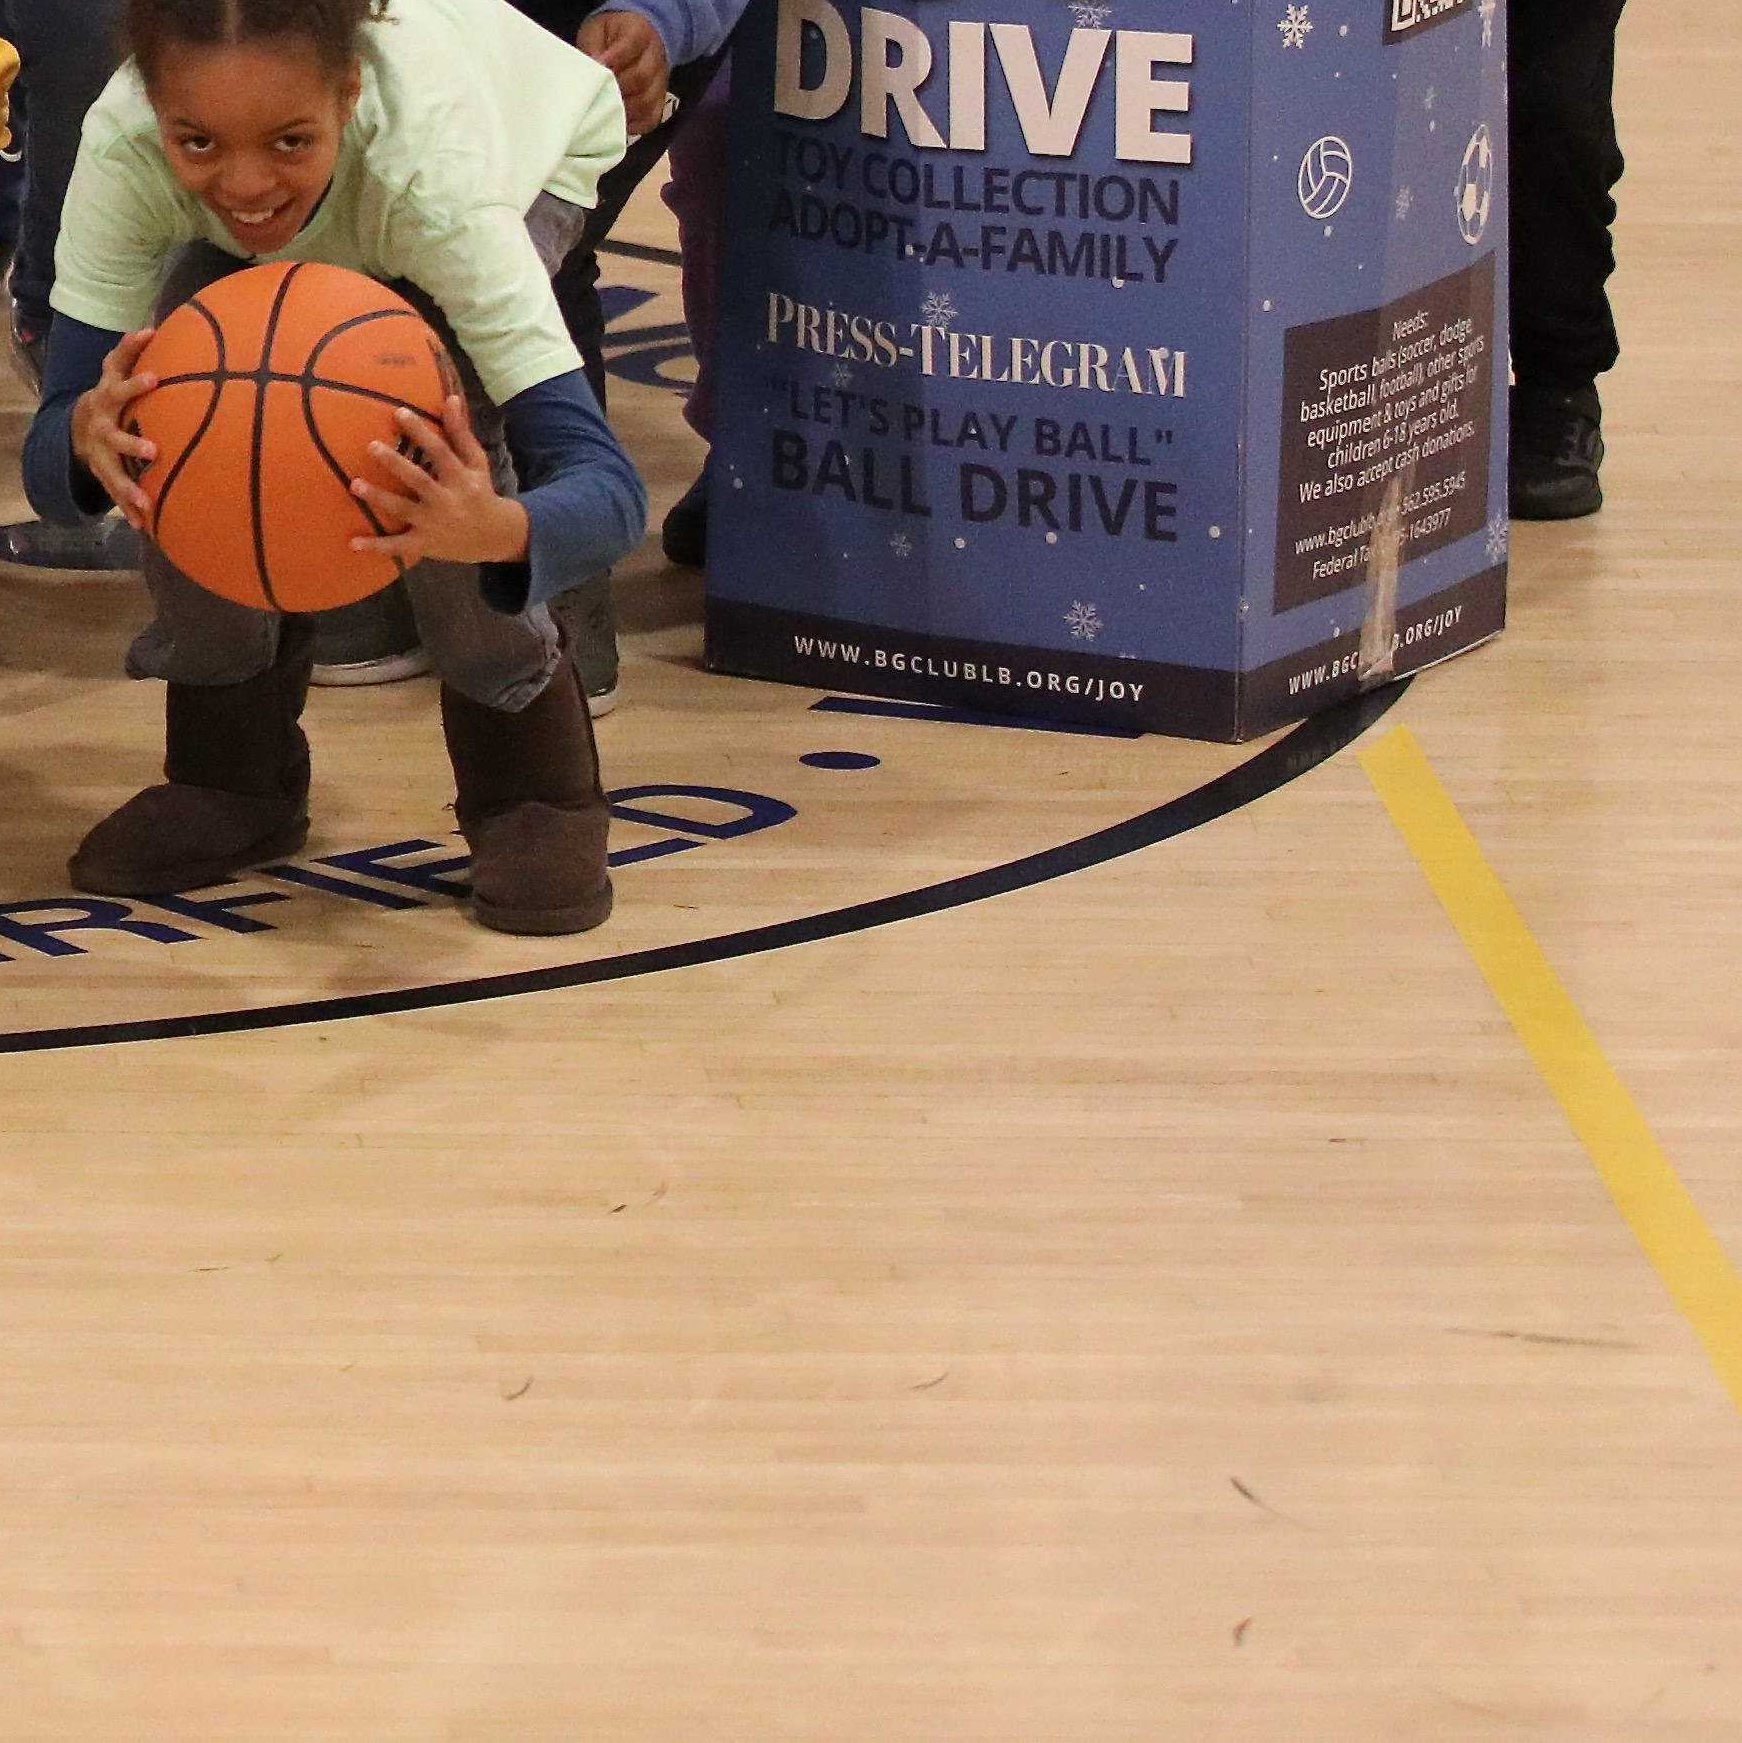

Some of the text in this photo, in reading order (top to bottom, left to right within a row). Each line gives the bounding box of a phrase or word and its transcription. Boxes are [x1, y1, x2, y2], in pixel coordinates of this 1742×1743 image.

[773, 130, 1181, 227] TOY COLLECTION
[766, 187, 1179, 285] ADOPT-A-FAMILY
[765, 291, 1187, 399] PRESS-TELEGRAM
[1318, 362, 1367, 395] Sports
[1371, 348, 1396, 377] balls
[1439, 316, 1474, 346] dodge
[1391, 309, 1430, 341] Needs:
[1426, 349, 1456, 379] other
[1457, 334, 1485, 366] sports
[903, 403, 1019, 453] PLAY
[1306, 404, 1382, 451] equipment
[1382, 402, 1393, 424] &
[1393, 394, 1417, 421] toys
[1418, 382, 1440, 409] and
[1440, 372, 1465, 405] gifts
[1327, 435, 1381, 471] children
[1382, 421, 1407, 451] 6-18
[1407, 412, 1438, 446] years
[771, 426, 1179, 543] BALL DRIVE
[1299, 480, 1321, 504] We
[1323, 469, 1354, 497] also
[1356, 455, 1393, 489] accept
[1394, 441, 1420, 471] cash
[1312, 550, 1354, 580] Federal
[793, 634, 1146, 705] WWW.BGCLUBLB.ORG/JOY
